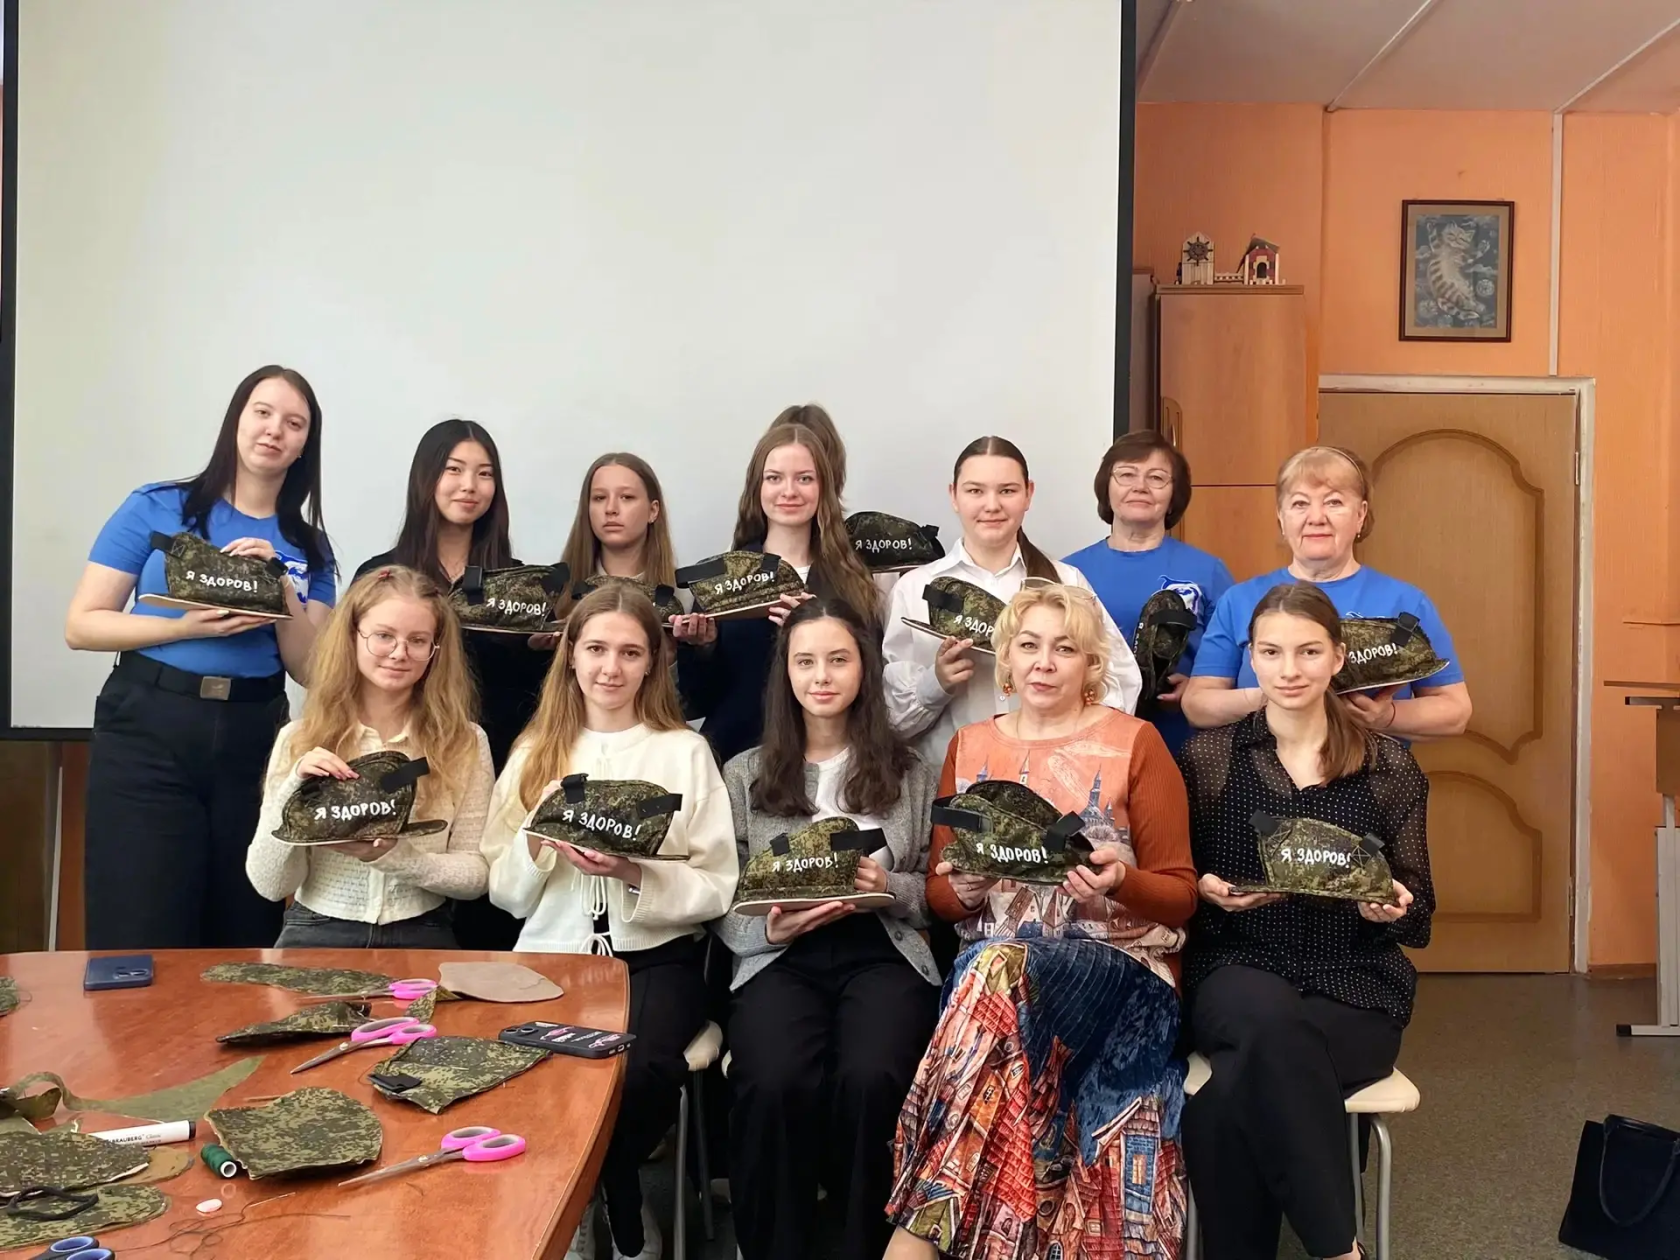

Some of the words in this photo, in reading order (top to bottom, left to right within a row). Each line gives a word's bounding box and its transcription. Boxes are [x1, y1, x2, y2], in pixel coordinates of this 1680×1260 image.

[855, 539, 863, 551] Я
[865, 537, 913, 554] ЗДОРОВ!
[185, 570, 196, 581] Я
[199, 573, 258, 593] ЗДОРОВ!
[714, 582, 724, 595] Я
[724, 571, 775, 593] ЗДОРОВ!
[486, 597, 496, 607] Я
[498, 599, 547, 617] ЗДОРОВ!
[953, 614, 963, 625] Я
[964, 616, 995, 637] ЗДОР
[1348, 642, 1398, 665] ЗДОРОВ!
[314, 806, 327, 820] Я
[331, 799, 397, 821] ЗДОРОВ!
[562, 809, 574, 823] Я
[578, 811, 642, 841] ЗДОРОВ!
[771, 860, 780, 873] Я
[785, 851, 839, 873] ЗДОРОВ!
[975, 842, 985, 855] Я
[989, 843, 1049, 864] ЗДОРОВ!
[1280, 848, 1292, 863] Я
[1296, 847, 1352, 869] ЗДОРОВ!
